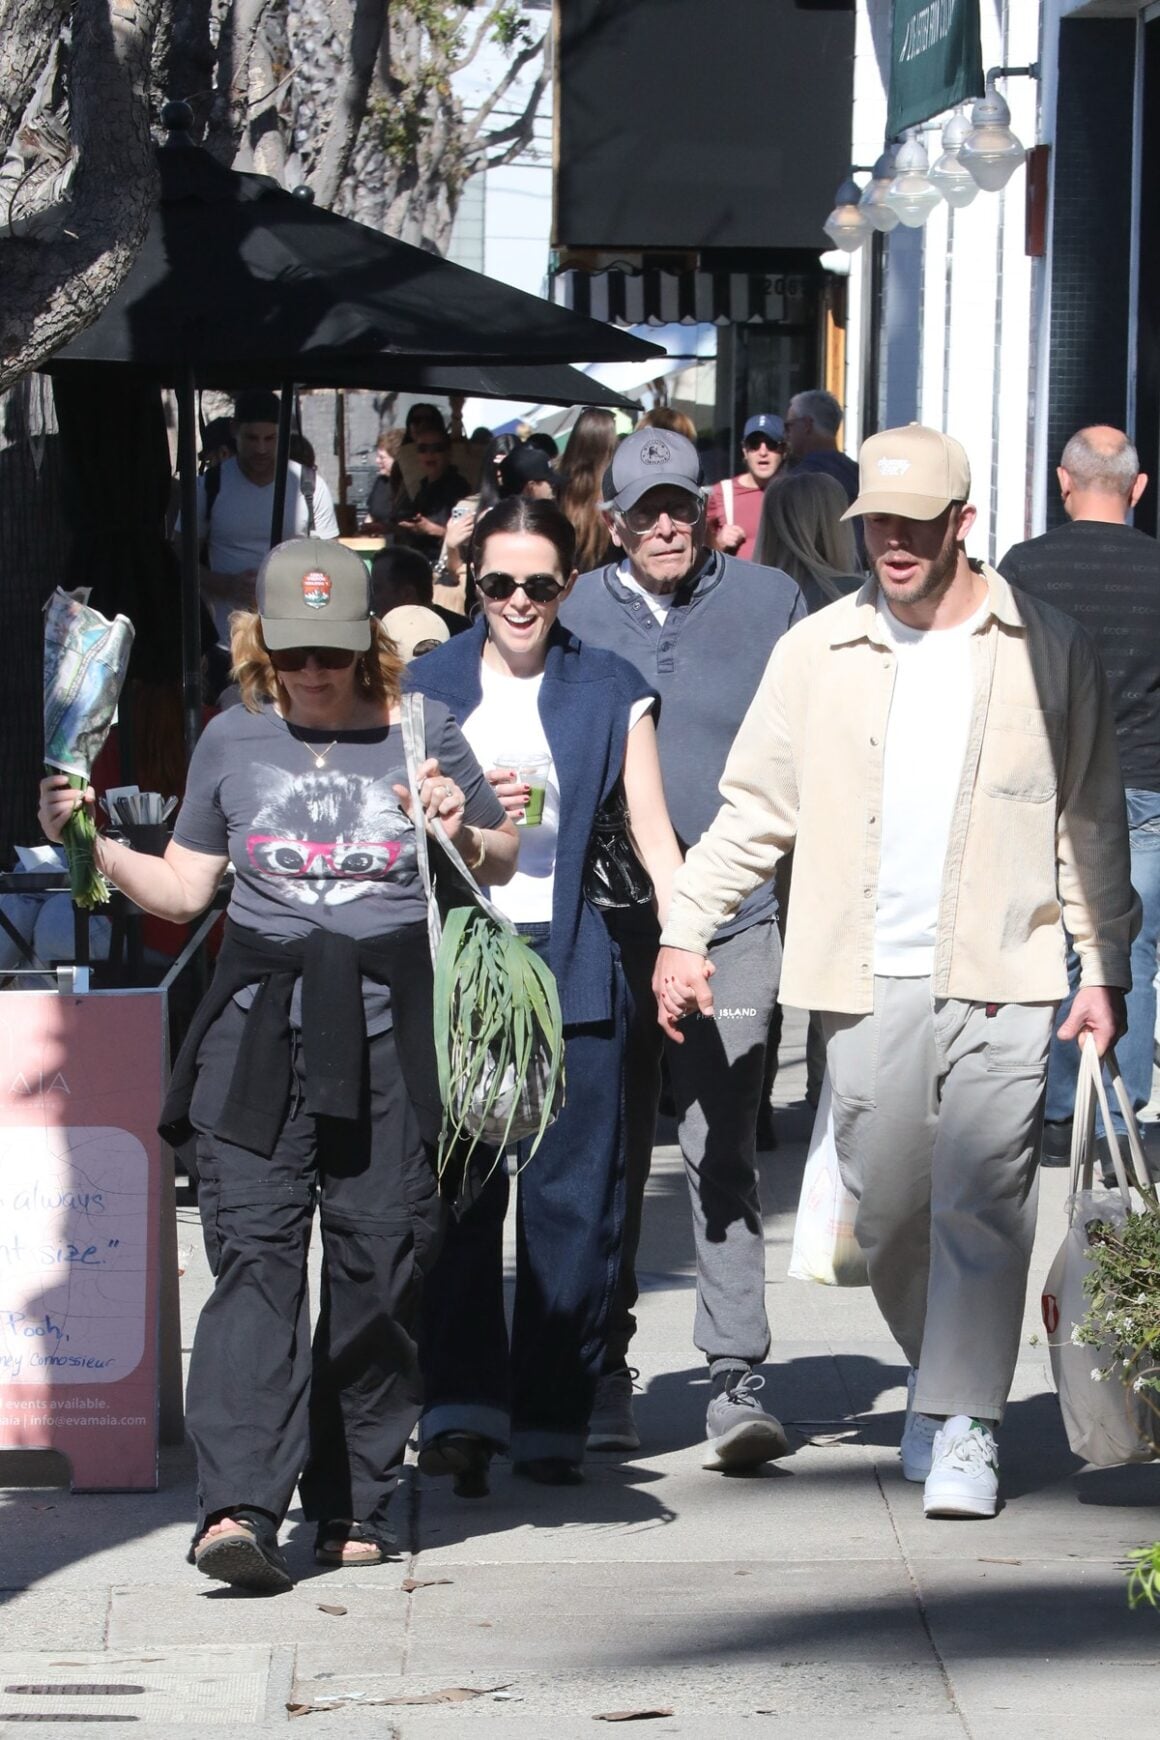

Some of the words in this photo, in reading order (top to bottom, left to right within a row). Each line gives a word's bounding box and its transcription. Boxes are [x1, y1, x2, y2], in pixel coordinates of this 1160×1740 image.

[719, 1008, 757, 1017] ISLAND
[12, 1179, 106, 1214] always
[6, 1398, 47, 1410] events
[49, 1396, 111, 1410] available.
[31, 1413, 147, 1427] info@evamaia.com
